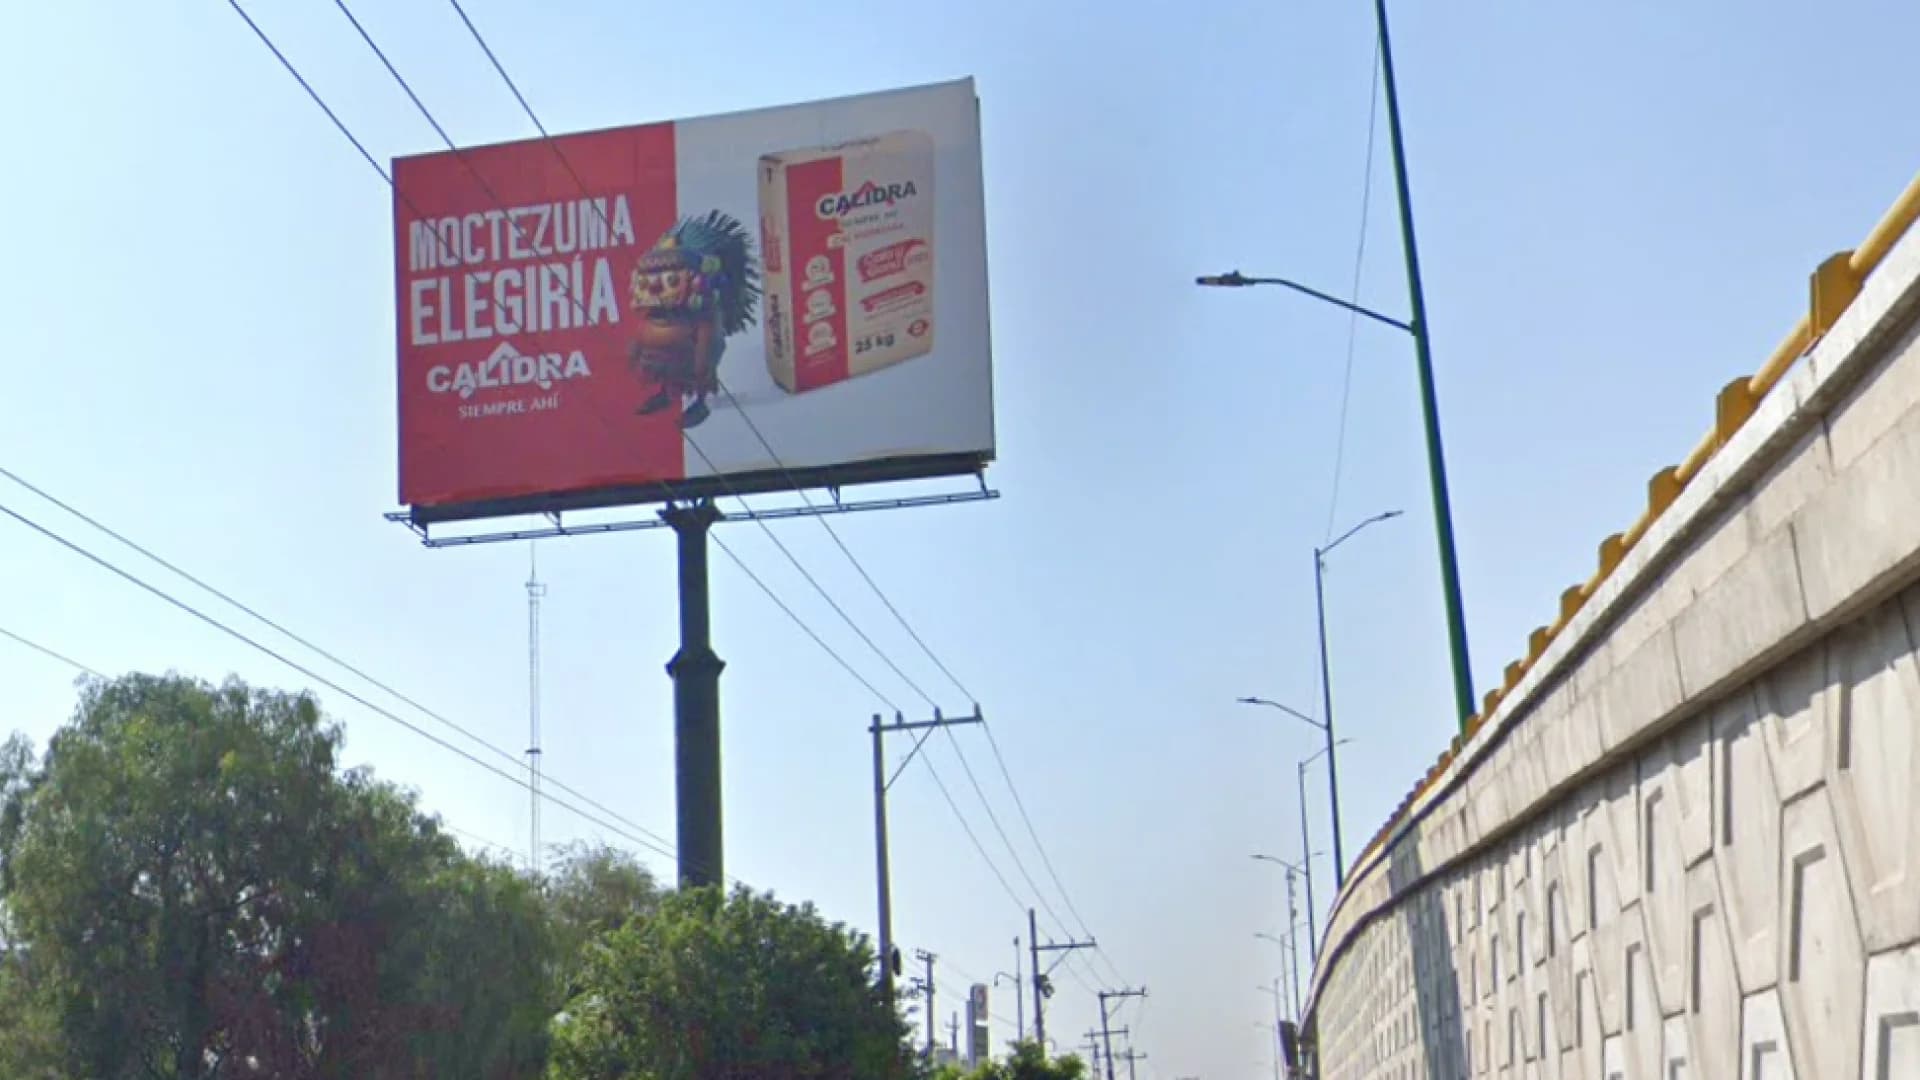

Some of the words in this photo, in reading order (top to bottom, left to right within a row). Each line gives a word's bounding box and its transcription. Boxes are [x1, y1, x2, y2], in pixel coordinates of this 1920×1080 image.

[819, 180, 917, 216] CALIDRA
[408, 194, 635, 272] MOCTEZUMA
[410, 252, 620, 345] ELEGIRÍA
[855, 338, 873, 355] 25
[876, 333, 895, 348] kg
[426, 341, 592, 399] CALIDRA
[459, 397, 526, 419] SIEMPRE
[530, 391, 560, 410] AHÍ
